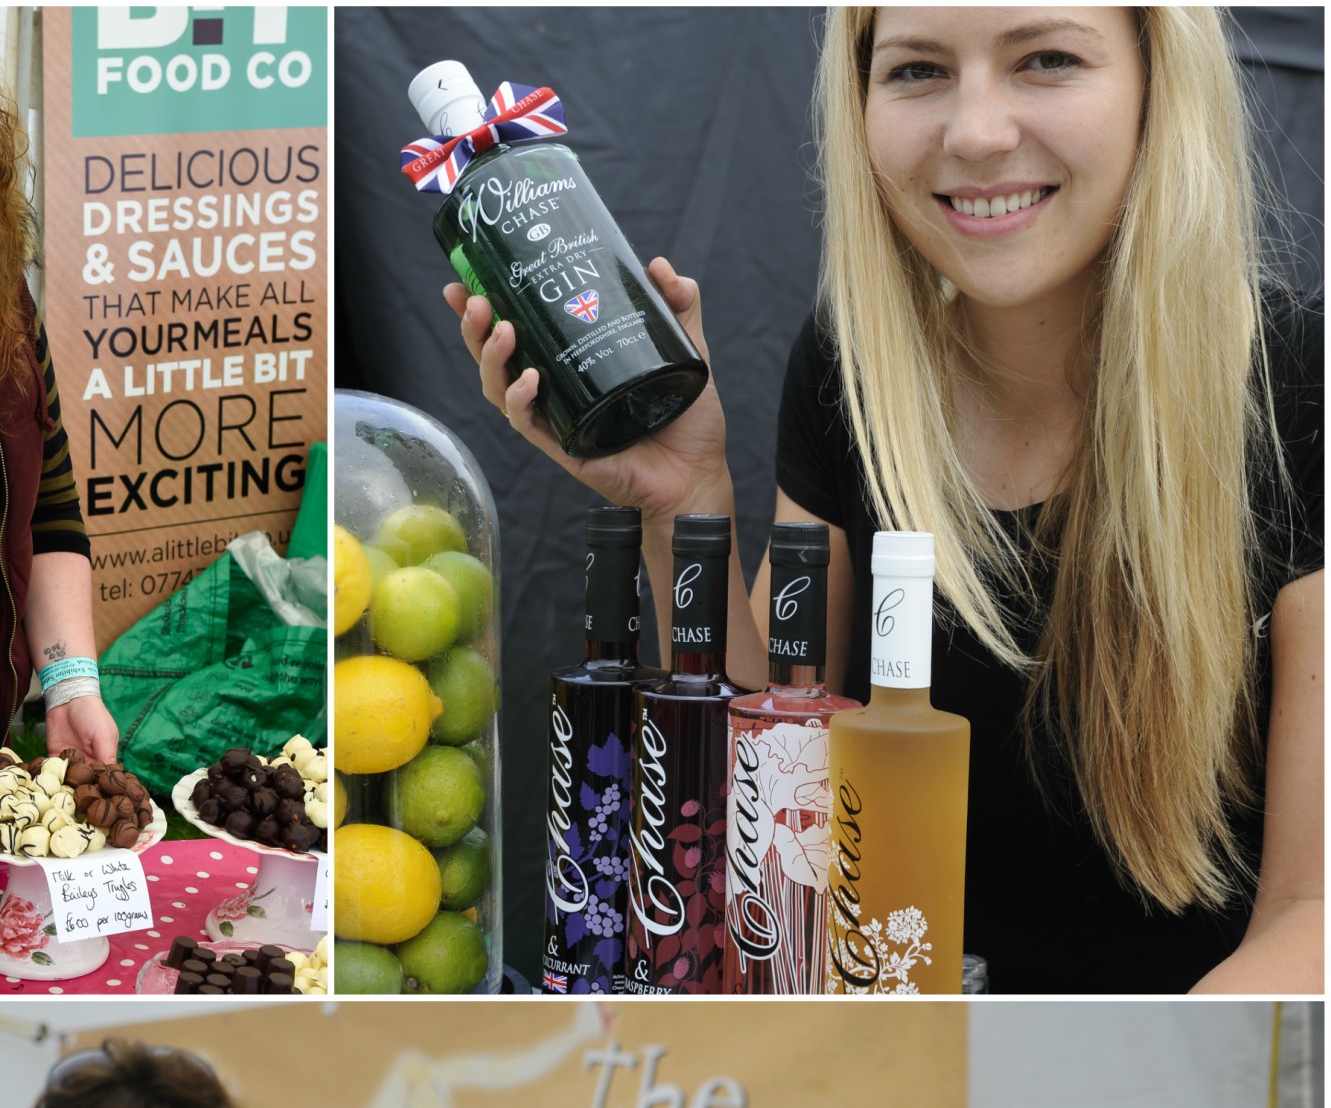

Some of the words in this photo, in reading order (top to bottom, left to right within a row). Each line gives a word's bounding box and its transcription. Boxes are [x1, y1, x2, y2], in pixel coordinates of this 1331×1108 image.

[96, 53, 231, 94] FOOD
[246, 50, 312, 90] CO
[510, 86, 545, 115] CHASE
[84, 144, 320, 195] DELICIOUS
[411, 146, 447, 174] GREAT
[82, 190, 319, 236] DRESSINGS
[458, 174, 577, 243] Williams
[501, 198, 559, 236] CHASE
[529, 224, 550, 240] GB
[82, 243, 116, 285] &
[127, 230, 317, 283] SAUCES
[509, 249, 547, 288] Great
[547, 227, 599, 261] British
[530, 262, 565, 286] EXTRA
[562, 248, 588, 270] DRY
[83, 290, 162, 320] THAT
[172, 284, 251, 312] MAKE
[260, 279, 315, 305] ALL
[539, 260, 601, 303] GIN
[82, 366, 113, 400] A
[123, 354, 244, 398] LITTLE
[253, 349, 314, 382] BIT
[578, 356, 596, 372] 40%
[89, 387, 307, 470] MORE
[86, 453, 306, 518] EXCITING
[100, 578, 133, 602] tel:
[672, 626, 711, 643] CHASE
[769, 637, 808, 657] CHASE
[872, 657, 911, 679] CHASE
[546, 704, 590, 926] Chase
[628, 717, 686, 949] Chase
[52, 869, 75, 883] Milk
[84, 869, 94, 878] or
[101, 860, 131, 875] White
[726, 729, 780, 975] Chase
[61, 883, 98, 911] Baileys
[829, 777, 880, 990] Chase
[97, 916, 109, 932] per
[547, 935, 559, 956] &
[634, 959, 649, 982] &
